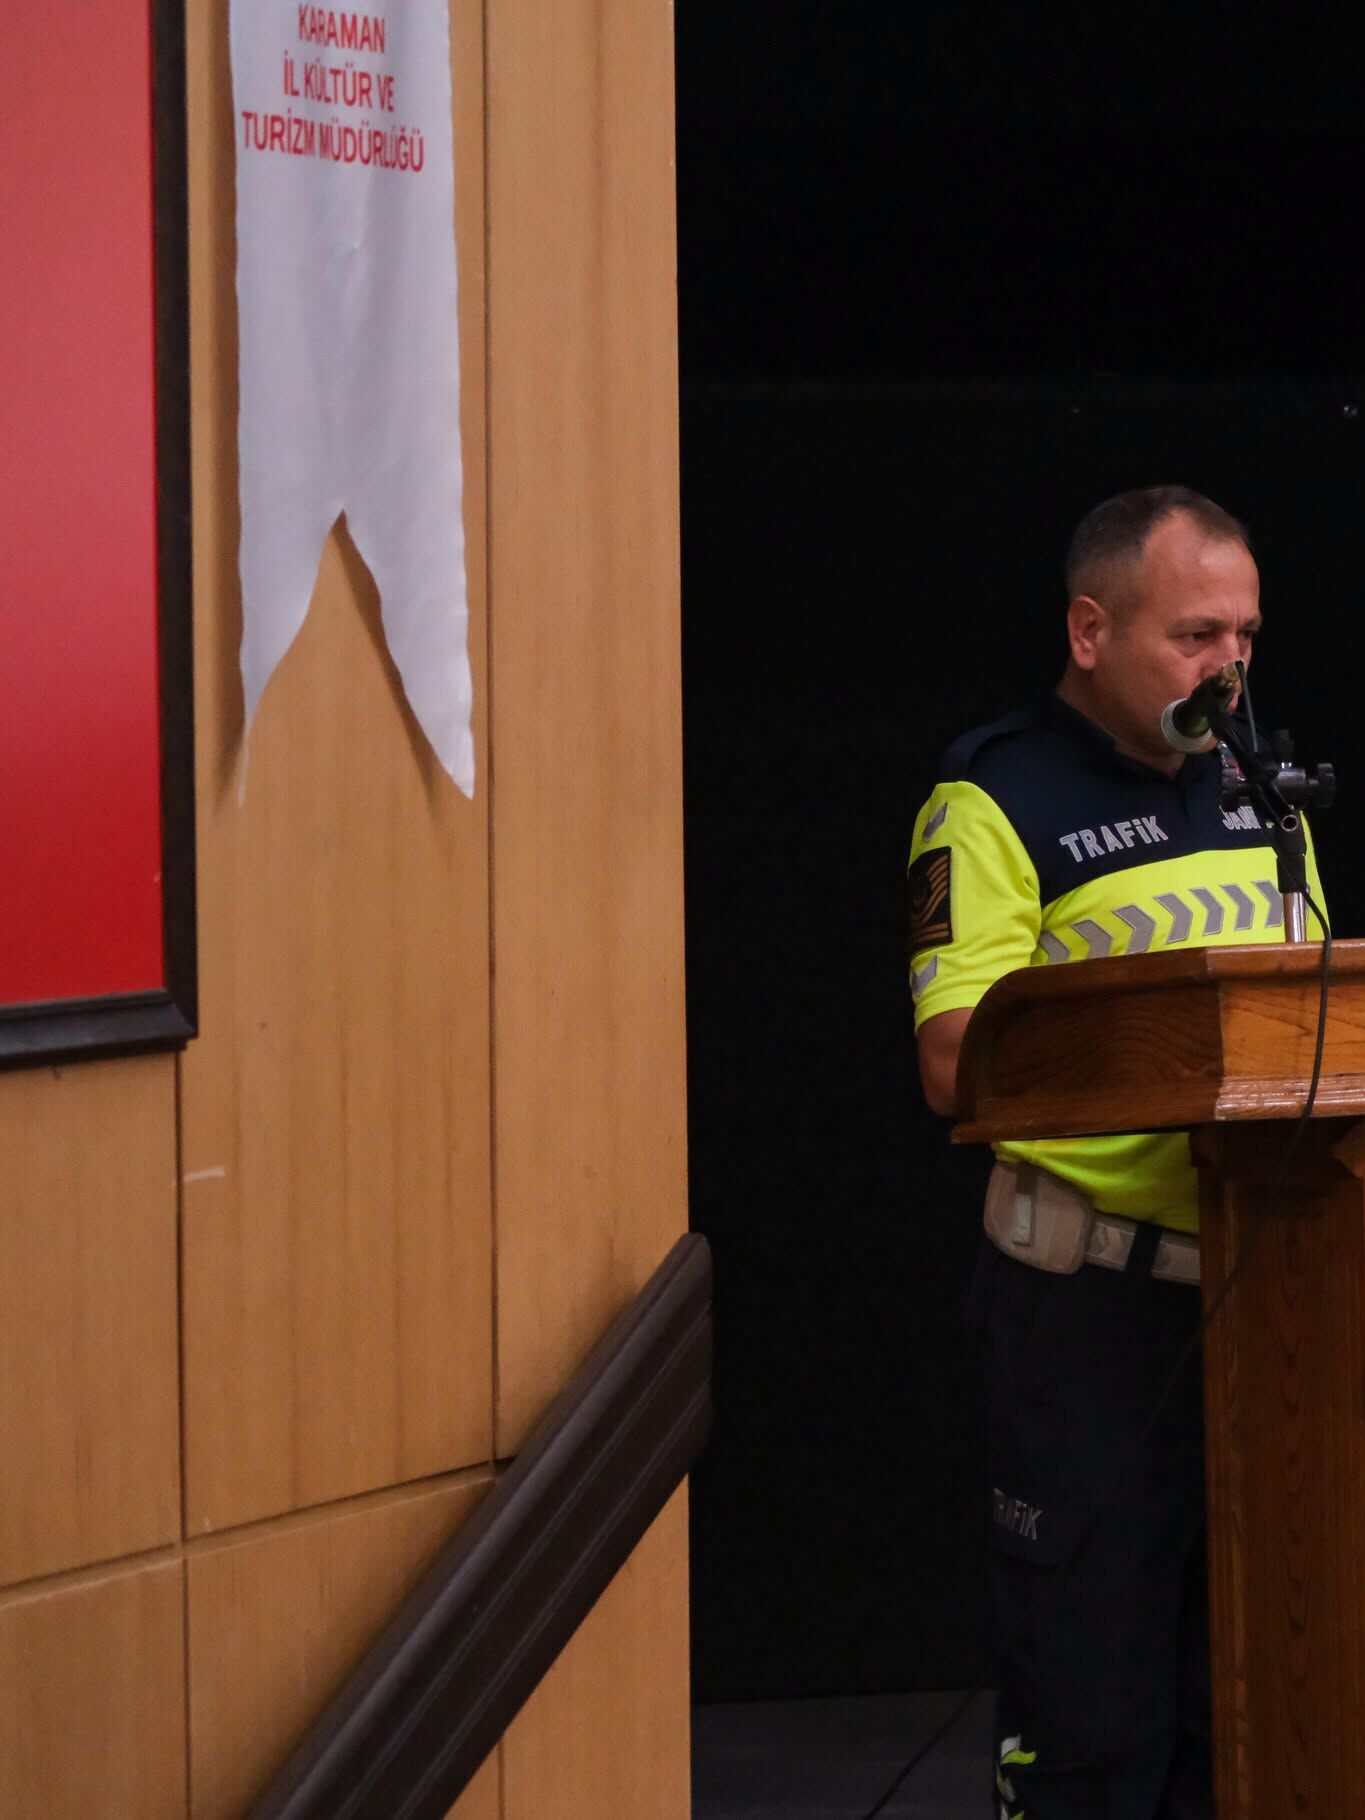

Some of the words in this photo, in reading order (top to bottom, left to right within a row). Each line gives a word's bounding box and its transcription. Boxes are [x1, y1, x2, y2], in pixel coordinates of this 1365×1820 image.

[298, 4, 386, 54] KARAMAN
[284, 50, 300, 97] İL
[304, 57, 372, 109] KÜLTÜR
[377, 74, 395, 112] VE
[242, 107, 316, 157] TURİZM
[319, 117, 425, 173] MÜDÜRLÜĞÜ
